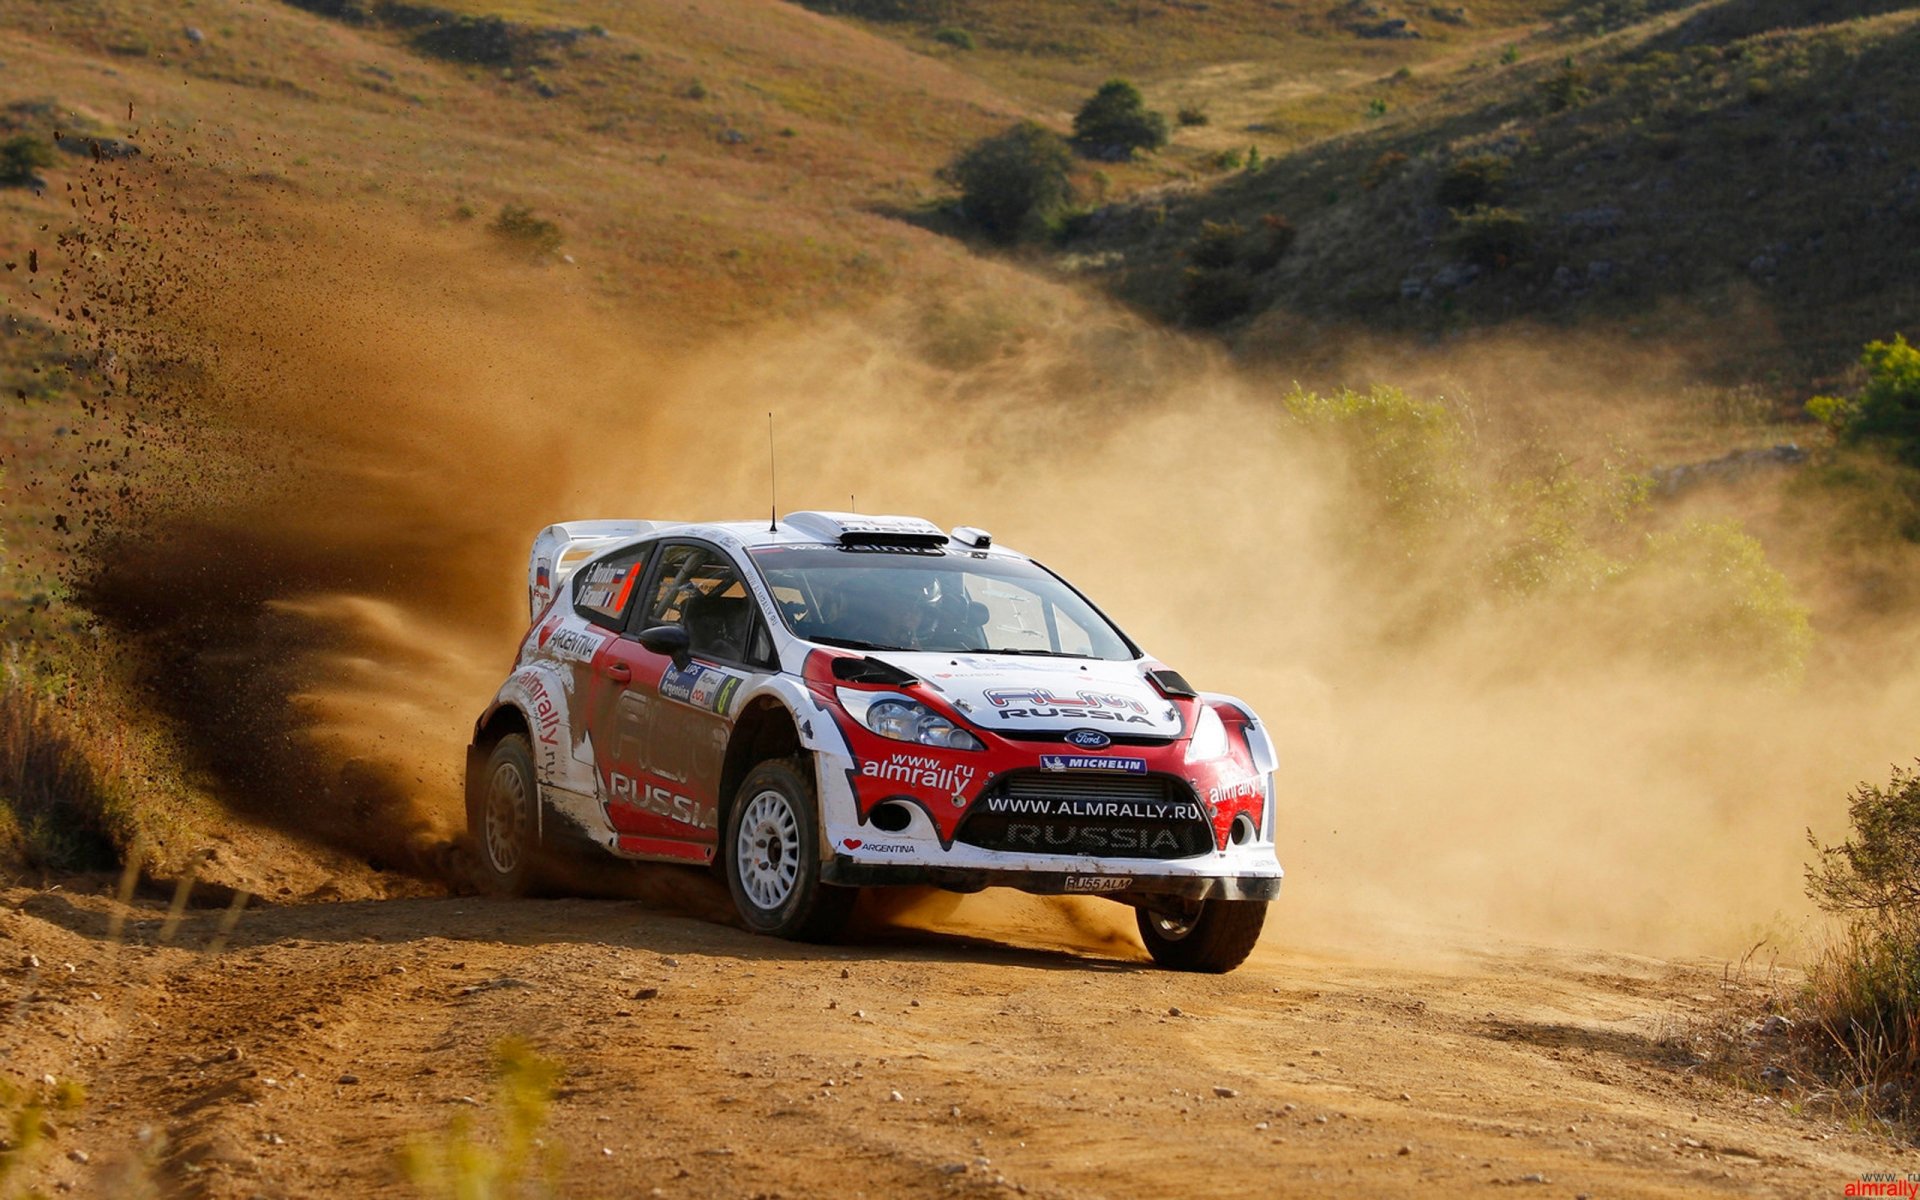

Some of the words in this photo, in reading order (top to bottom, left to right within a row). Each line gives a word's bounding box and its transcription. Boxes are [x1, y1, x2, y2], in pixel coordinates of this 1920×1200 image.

[549, 627, 599, 659] ARGENTINA
[983, 687, 1150, 715] ALM
[998, 707, 1157, 727] RUSSIA
[1075, 731, 1102, 745] Ford
[891, 753, 942, 771] www.
[954, 763, 976, 778] ru
[1068, 758, 1141, 771] MICHELIN
[862, 759, 970, 797] almrally
[987, 798, 1202, 821] WWW.ALMRALLY.RU
[1006, 823, 1179, 849] RUSSIA
[862, 843, 915, 854] ARGENTINA
[1100, 878, 1131, 890] ALM
